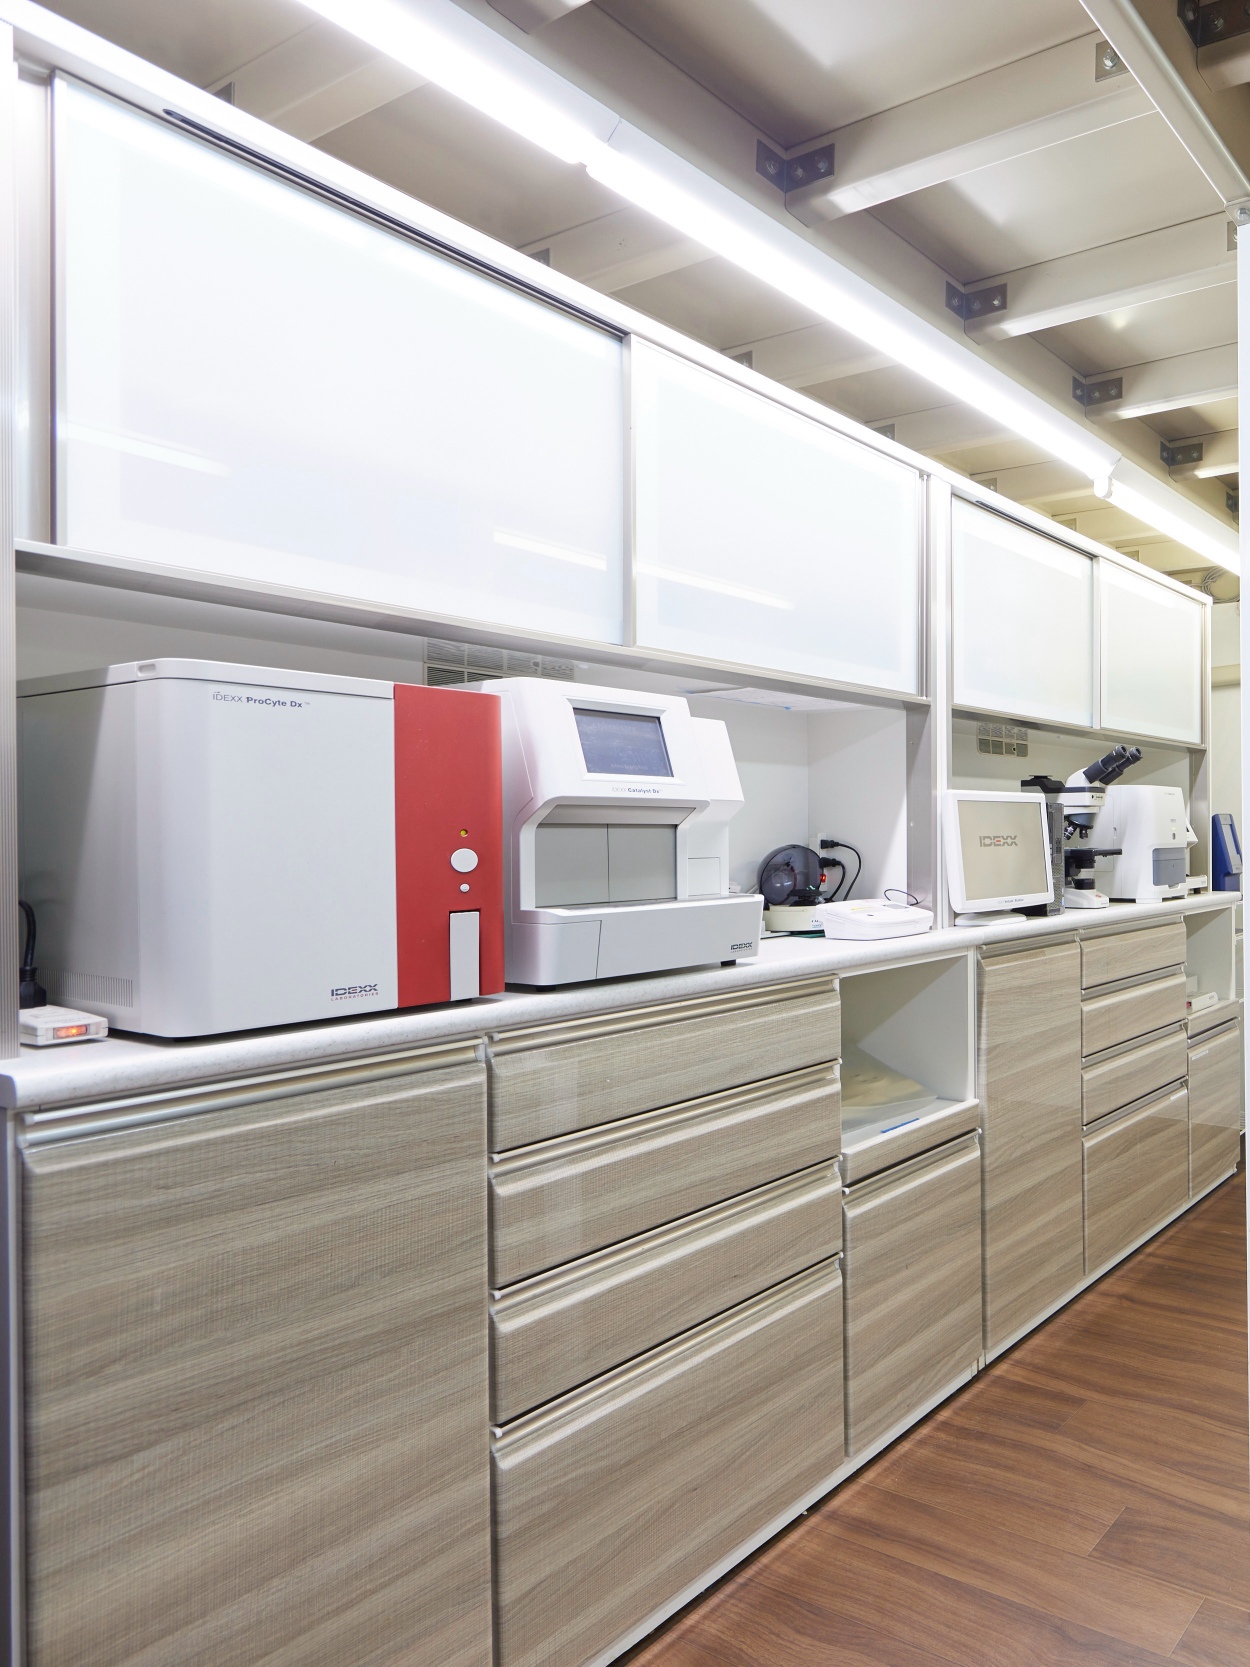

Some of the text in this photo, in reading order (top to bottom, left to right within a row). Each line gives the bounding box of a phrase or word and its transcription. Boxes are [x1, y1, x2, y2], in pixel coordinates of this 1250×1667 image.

[212, 692, 243, 703] IDEXX
[246, 696, 287, 707] ProCyte
[979, 835, 1019, 847] IDEXX
[731, 942, 753, 951] IDEXX
[331, 984, 378, 997] IDEXX
[331, 992, 379, 1001] LABORATORIES
